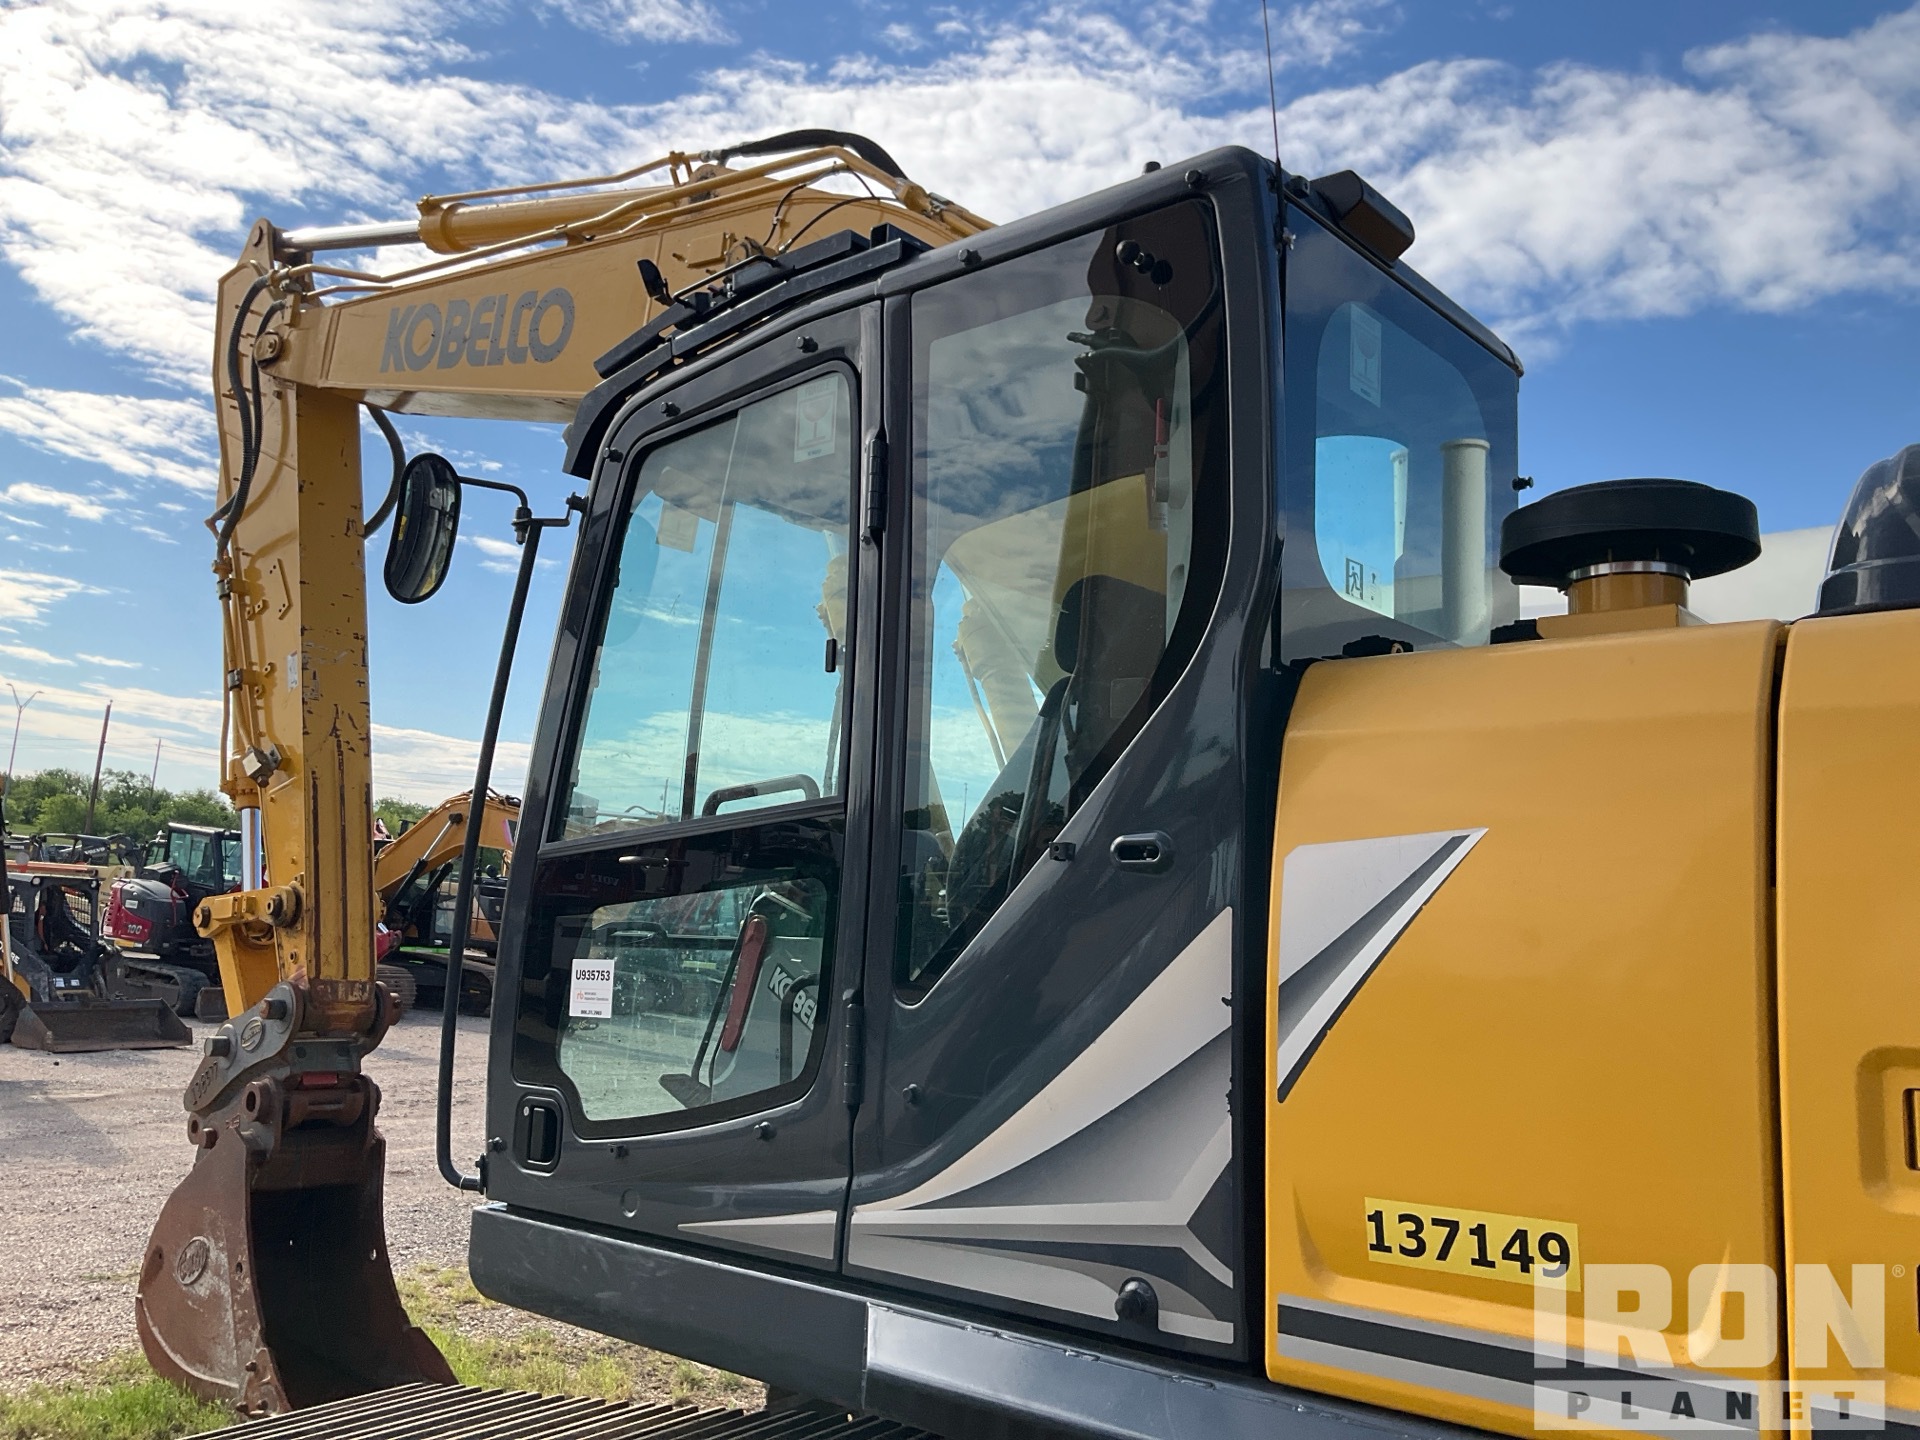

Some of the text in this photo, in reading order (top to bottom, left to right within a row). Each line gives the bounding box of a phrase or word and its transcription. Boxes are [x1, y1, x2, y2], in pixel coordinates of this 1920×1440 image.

[379, 287, 576, 374] KOBELCO
[575, 969, 611, 981] U935753
[1366, 1209, 1571, 1278] 137149
